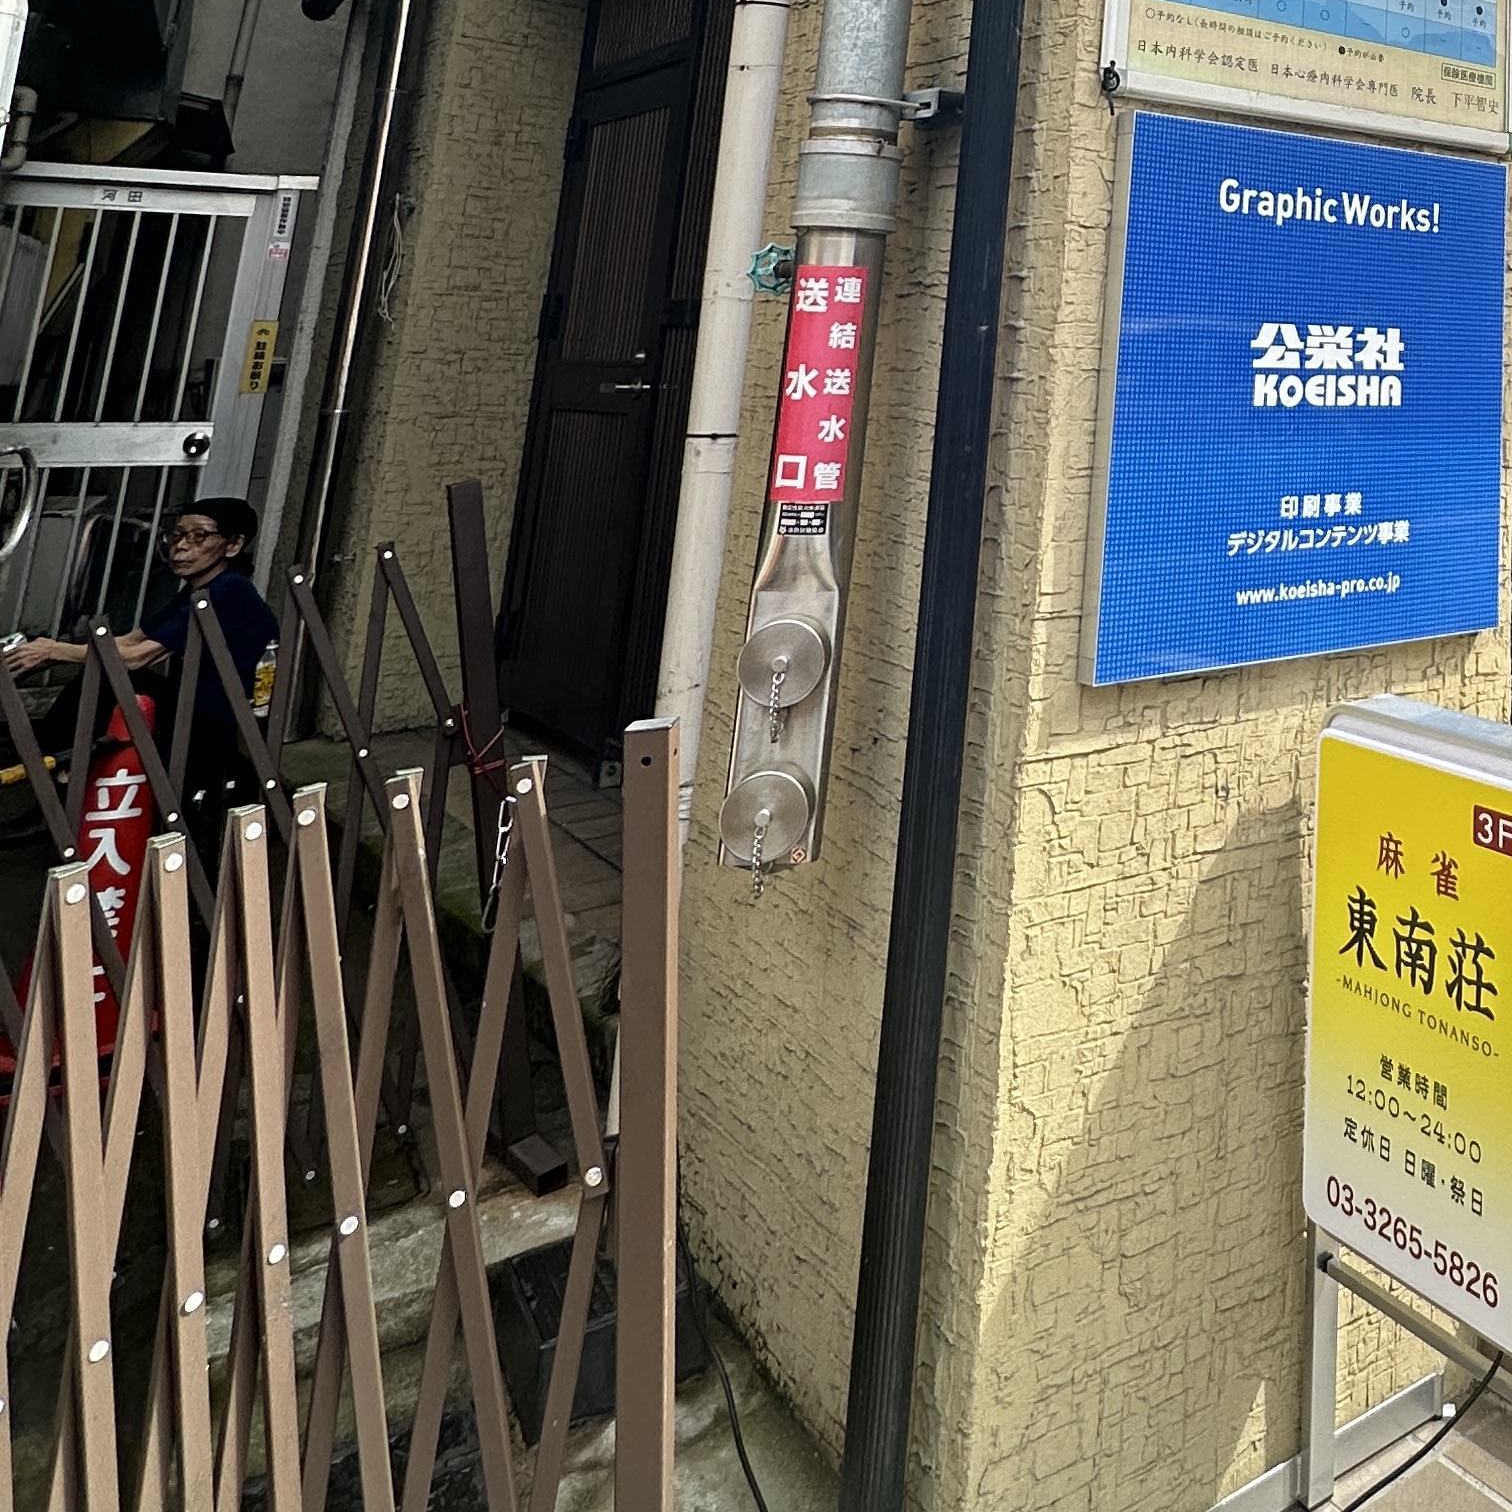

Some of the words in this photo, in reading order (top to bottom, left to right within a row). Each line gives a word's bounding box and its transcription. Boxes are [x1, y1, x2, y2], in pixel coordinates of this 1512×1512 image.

[1410, 86, 1438, 106] 院長
[1219, 178, 1339, 227] Graphic
[1341, 191, 1441, 234] Works!
[1250, 322, 1405, 372] 公栄社
[774, 276, 830, 490] 送水口
[813, 275, 863, 491] 連結送水管
[1253, 373, 1402, 408] KOEISHA
[1280, 491, 1363, 520] 印刷事業
[1227, 519, 1411, 557] デジタルコンテンツ事業
[1235, 571, 1401, 606] www.koeisha-pro.co.jp
[1377, 831, 1460, 902] 麻雀
[1338, 884, 1499, 1022] 東南荘
[1379, 1053, 1448, 1111] 営業時間
[1343, 1116, 1392, 1163] 定休日
[1326, 1174, 1499, 1308] 03-3265-5826
